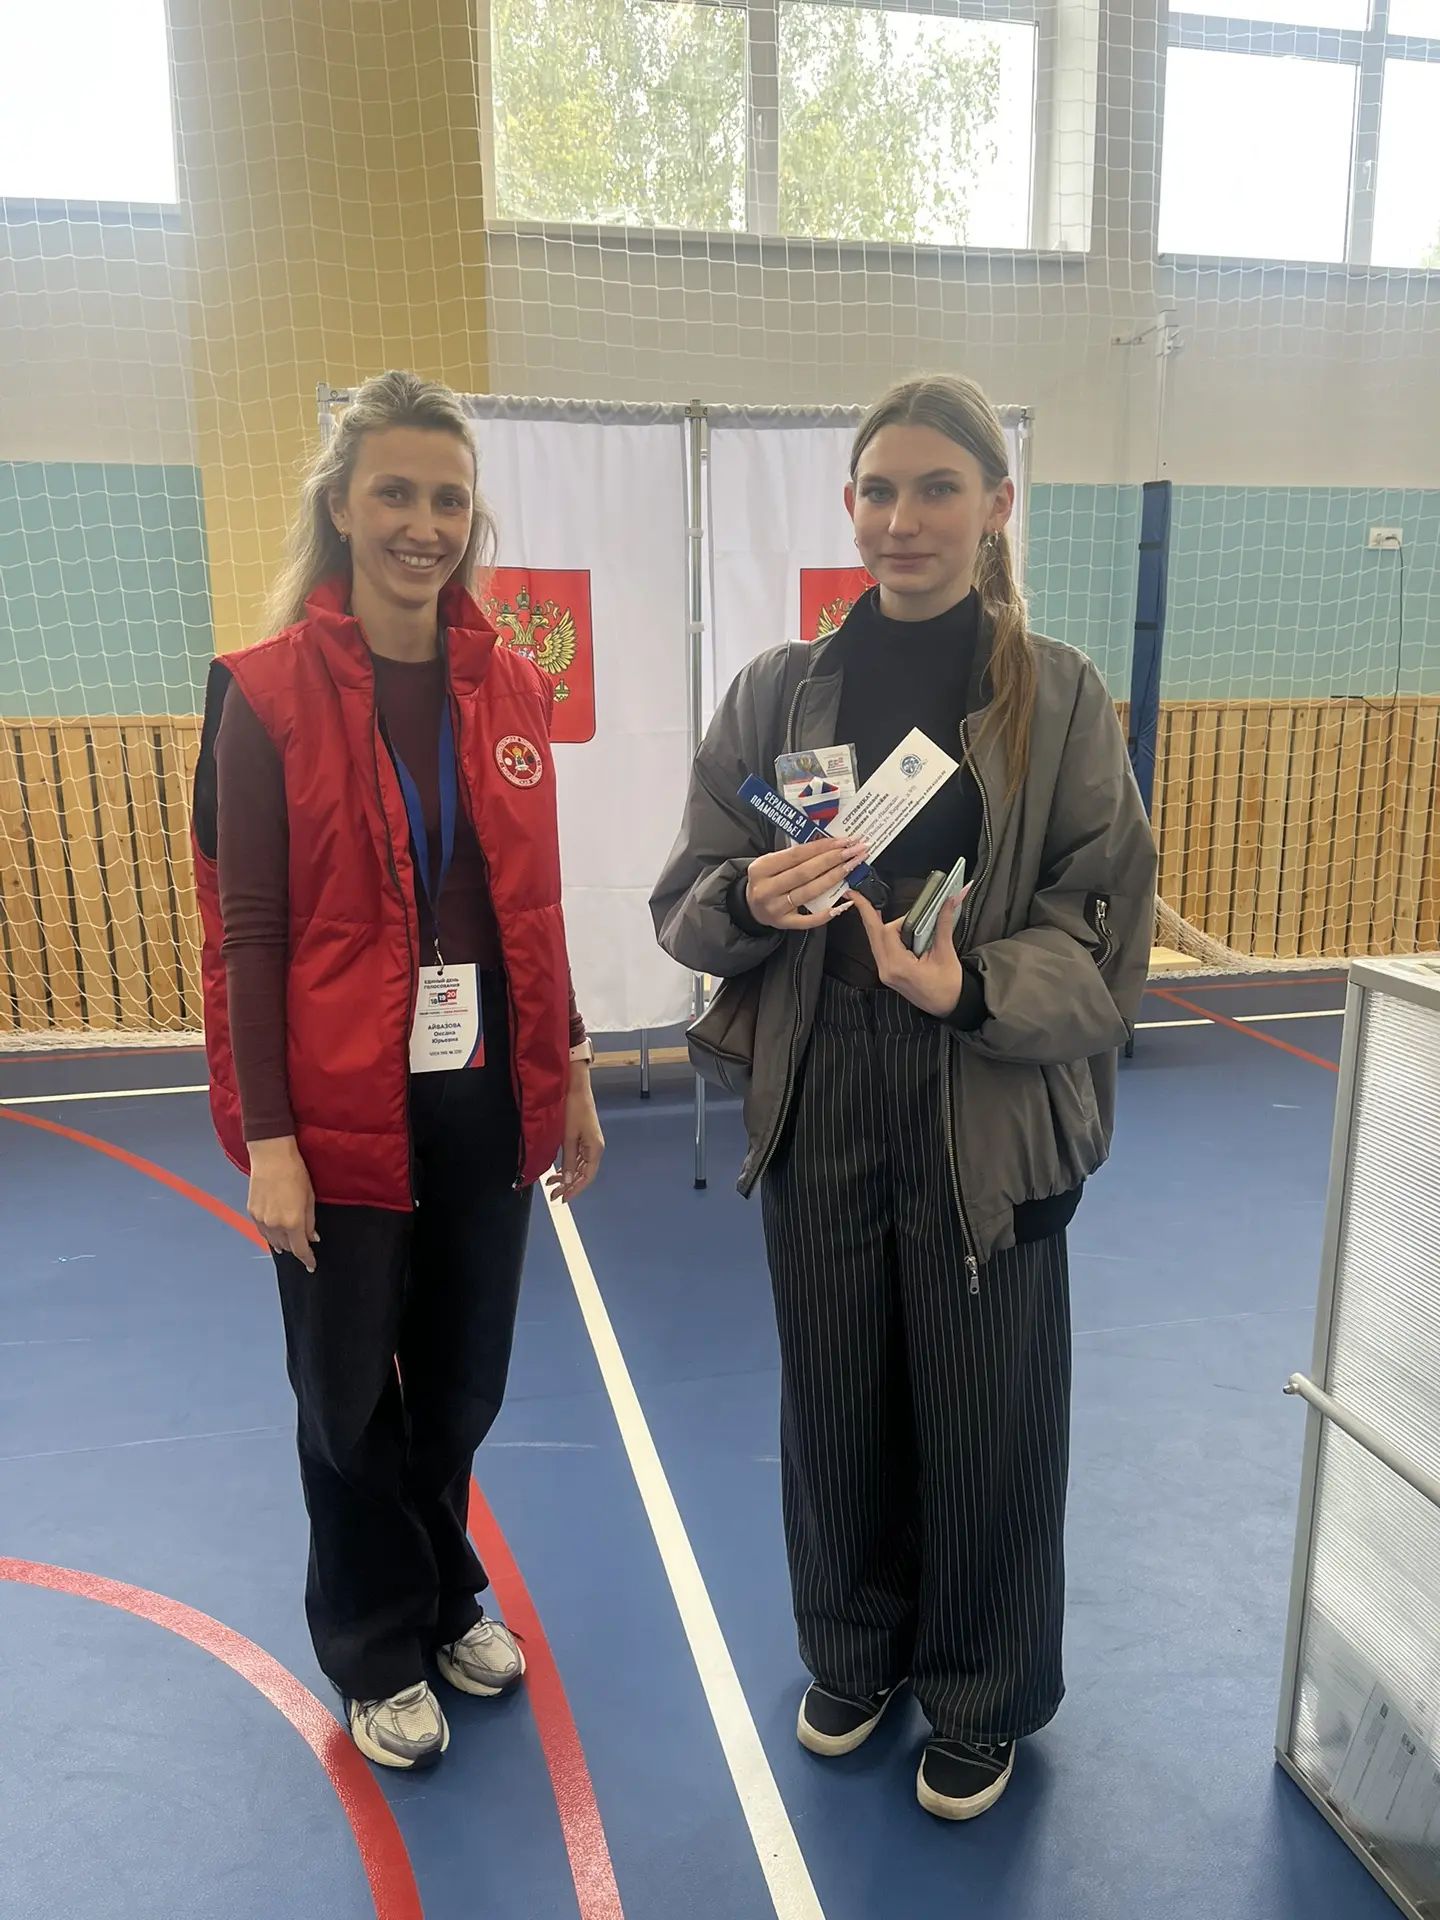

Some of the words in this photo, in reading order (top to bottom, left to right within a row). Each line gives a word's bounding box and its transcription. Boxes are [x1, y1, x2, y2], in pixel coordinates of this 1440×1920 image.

[749, 794, 802, 838] ПОДМОСКОВЬЕ!
[763, 791, 798, 820] СЕРДЦЕМ
[795, 815, 808, 828] ЗА
[841, 791, 873, 825] СЕРТИФИКАТ
[428, 1022, 461, 1030] АЙВАЗОВА
[432, 1036, 458, 1044] Юрьевна
